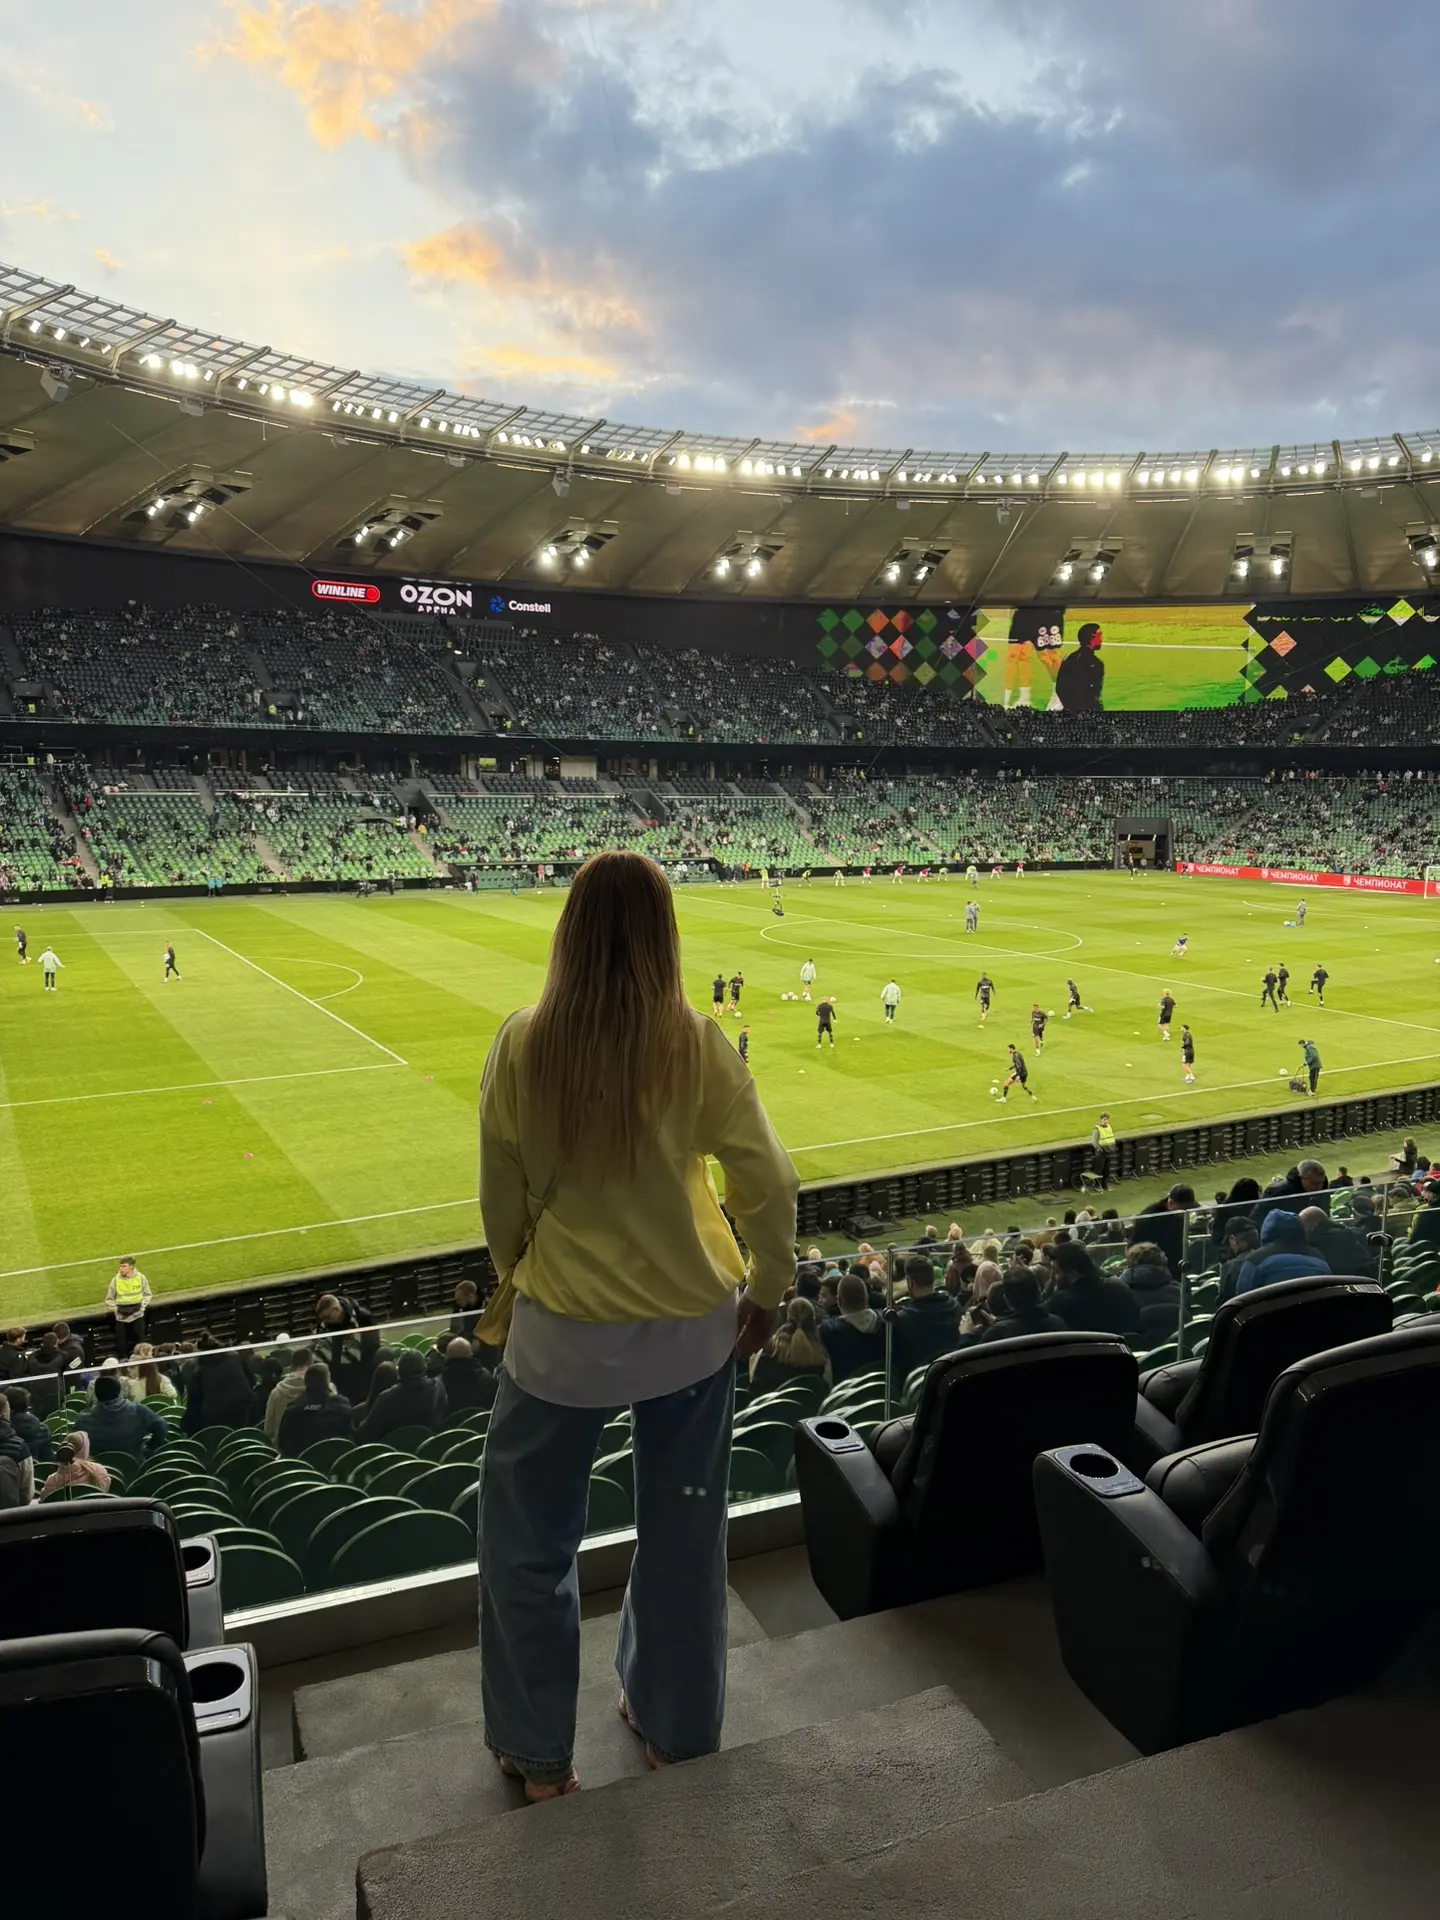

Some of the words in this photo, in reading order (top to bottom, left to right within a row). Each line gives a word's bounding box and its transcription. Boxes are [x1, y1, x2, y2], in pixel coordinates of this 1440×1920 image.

[317, 584, 366, 598] WINLINE
[400, 584, 472, 607] OZON
[508, 600, 551, 613] Constell
[1270, 871, 1320, 882] ЧЕМПИОНАТ
[1354, 878, 1408, 890] ЧЕМПИОНАТ
